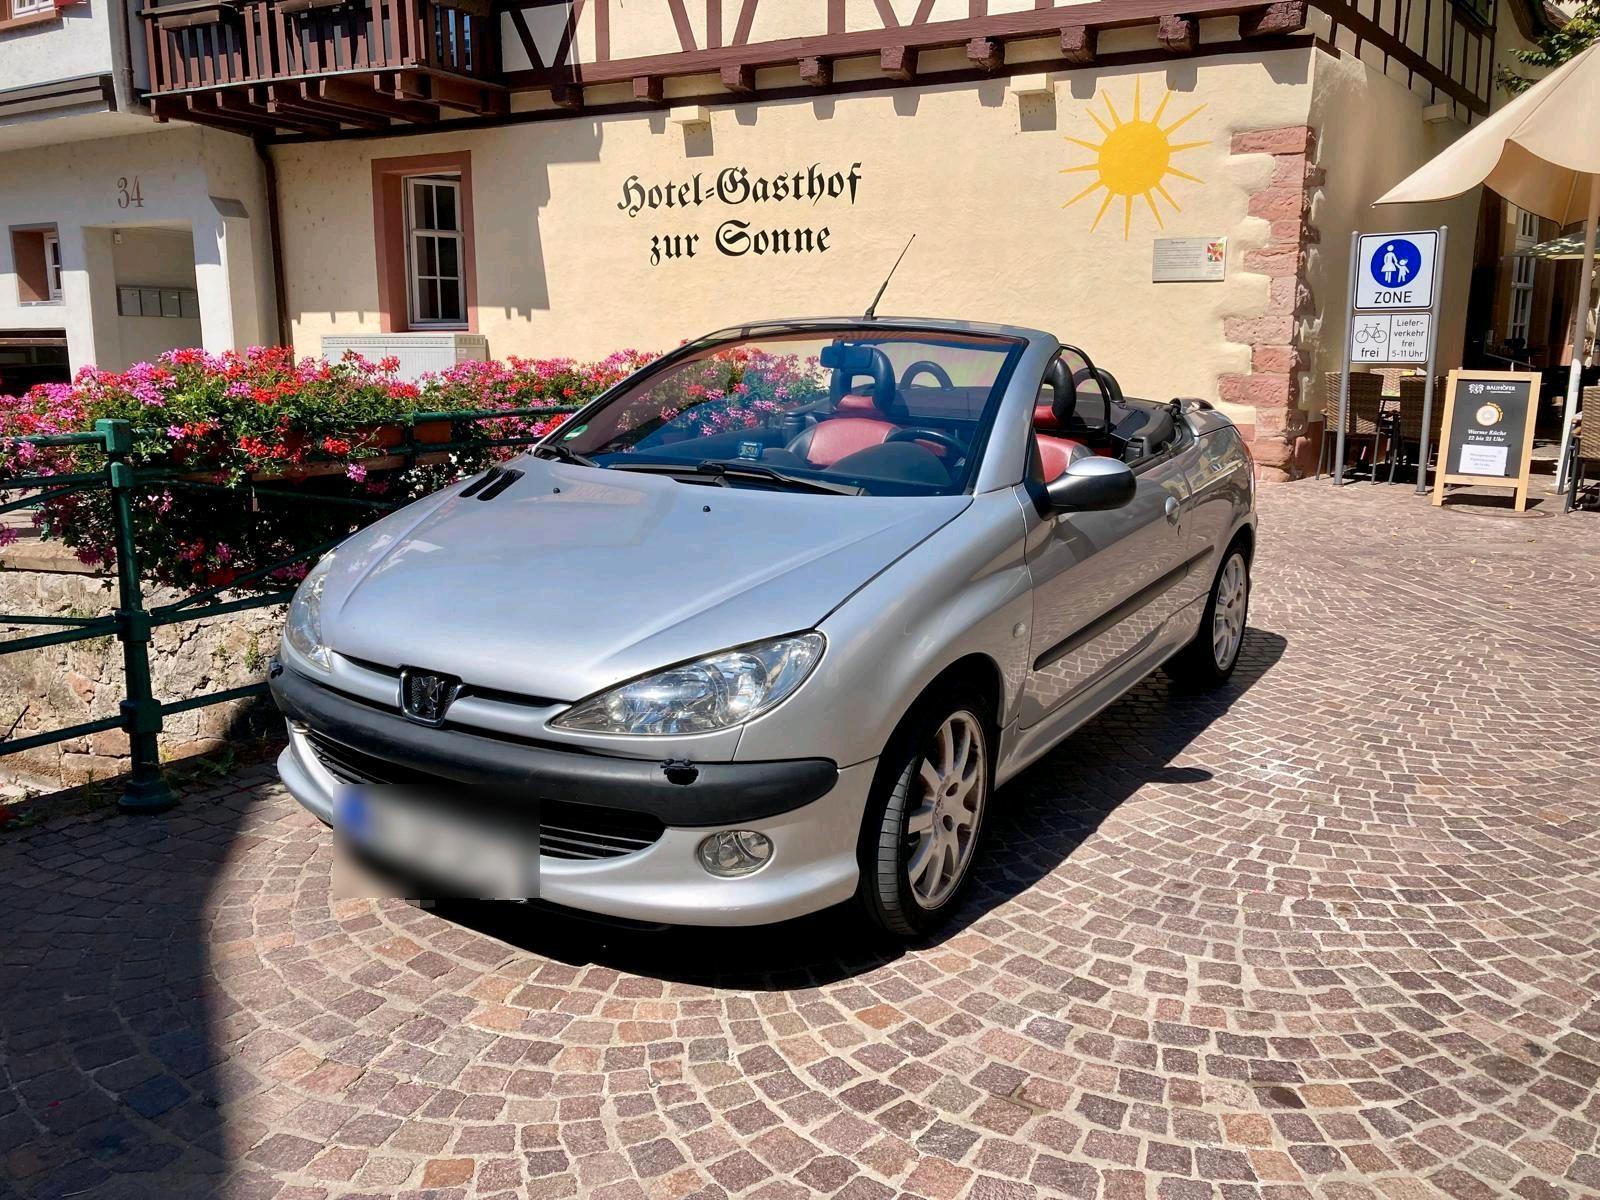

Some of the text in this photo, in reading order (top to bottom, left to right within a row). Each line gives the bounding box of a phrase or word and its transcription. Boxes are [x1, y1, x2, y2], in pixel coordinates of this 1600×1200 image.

[117, 175, 145, 209] 34
[649, 219, 831, 266] zur Sonne
[1374, 290, 1413, 304] ZONE
[1396, 319, 1424, 327] Liefer-
[1393, 329, 1425, 337] verkehr
[1361, 347, 1380, 358] frei
[1408, 350, 1424, 358] Uhr
